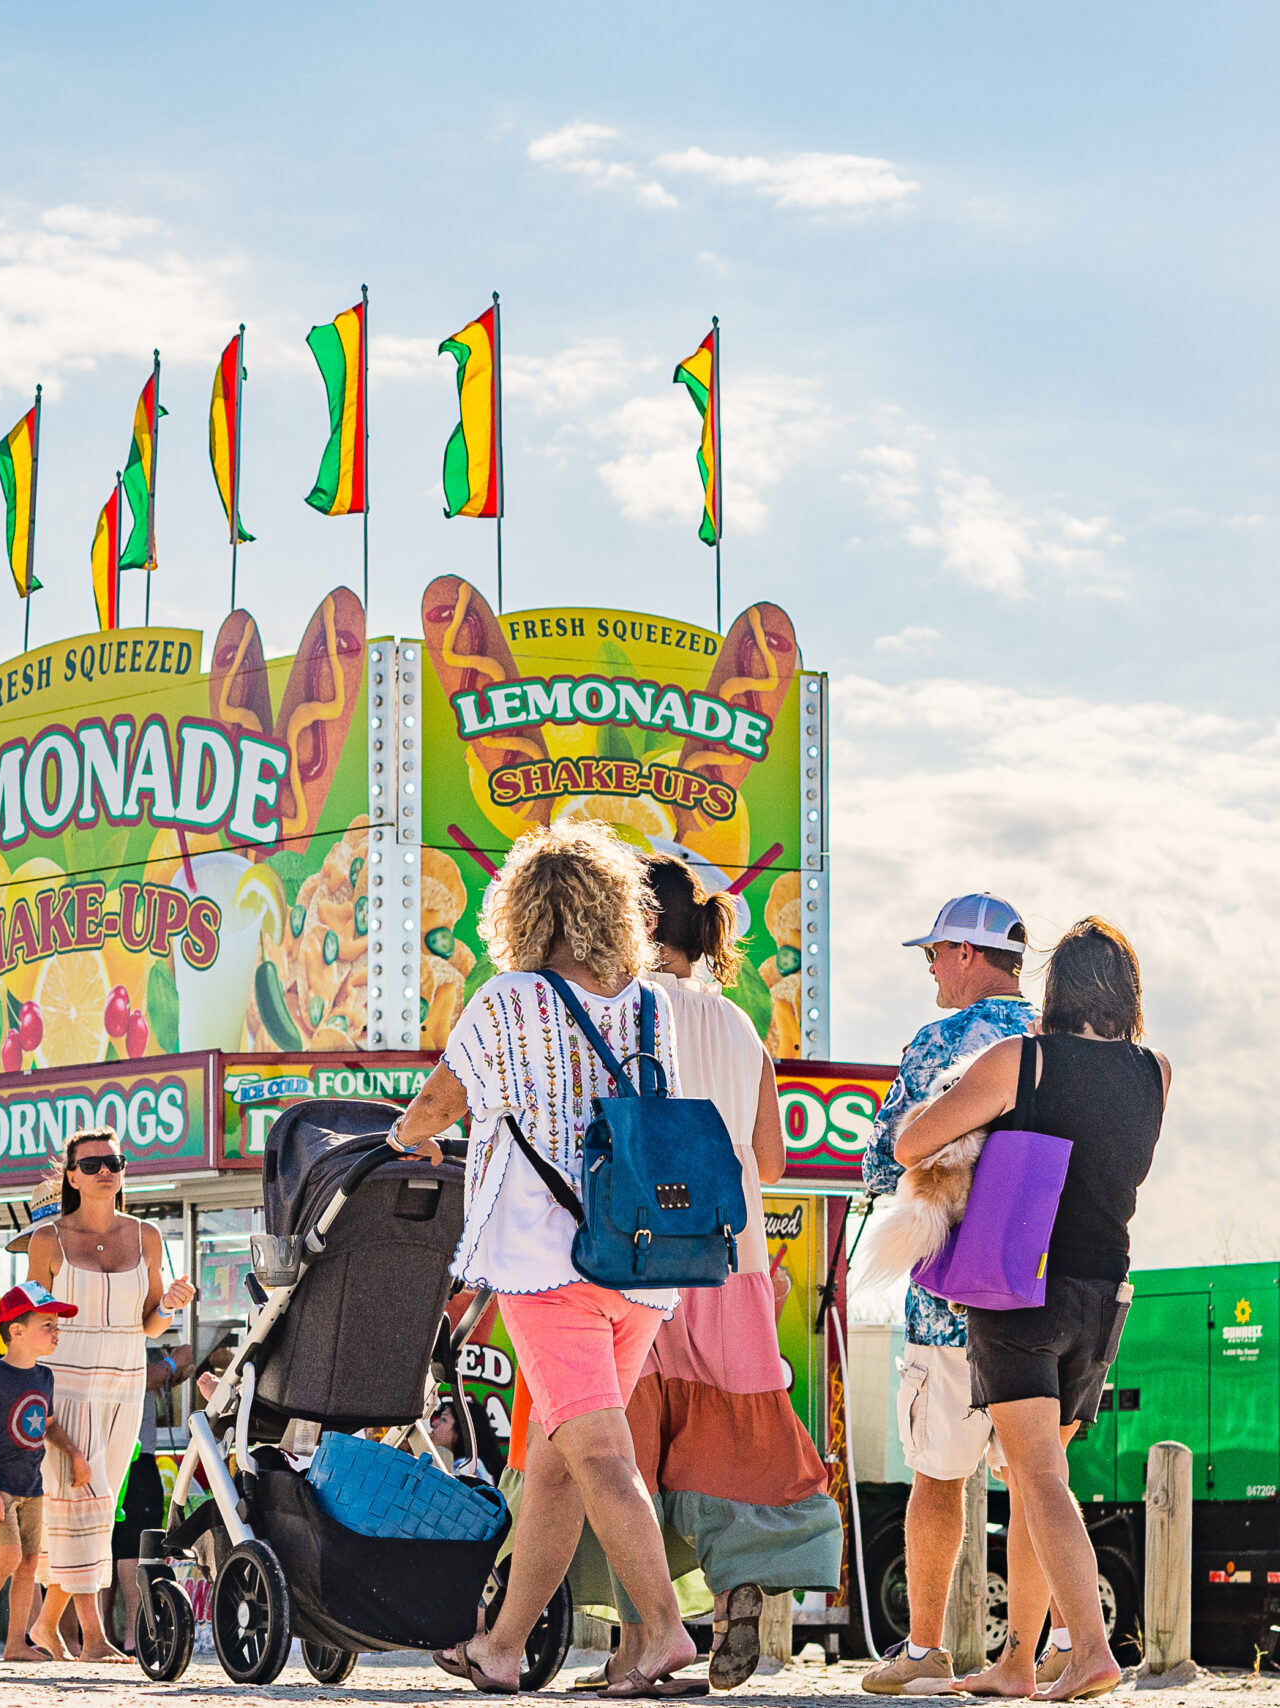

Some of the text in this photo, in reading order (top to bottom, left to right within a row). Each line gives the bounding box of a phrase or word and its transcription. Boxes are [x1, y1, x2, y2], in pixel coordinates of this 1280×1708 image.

[510, 617, 718, 656] FRESH SQUEEZED
[65, 640, 193, 684] SQUEEZED
[456, 679, 769, 757] LEMONADE
[492, 761, 735, 819] SHAKE-UPS
[240, 1078, 308, 1101] ICE COLD
[318, 1071, 426, 1096] FOUNTA
[779, 1092, 875, 1151] OS
[458, 1344, 513, 1385] ED
